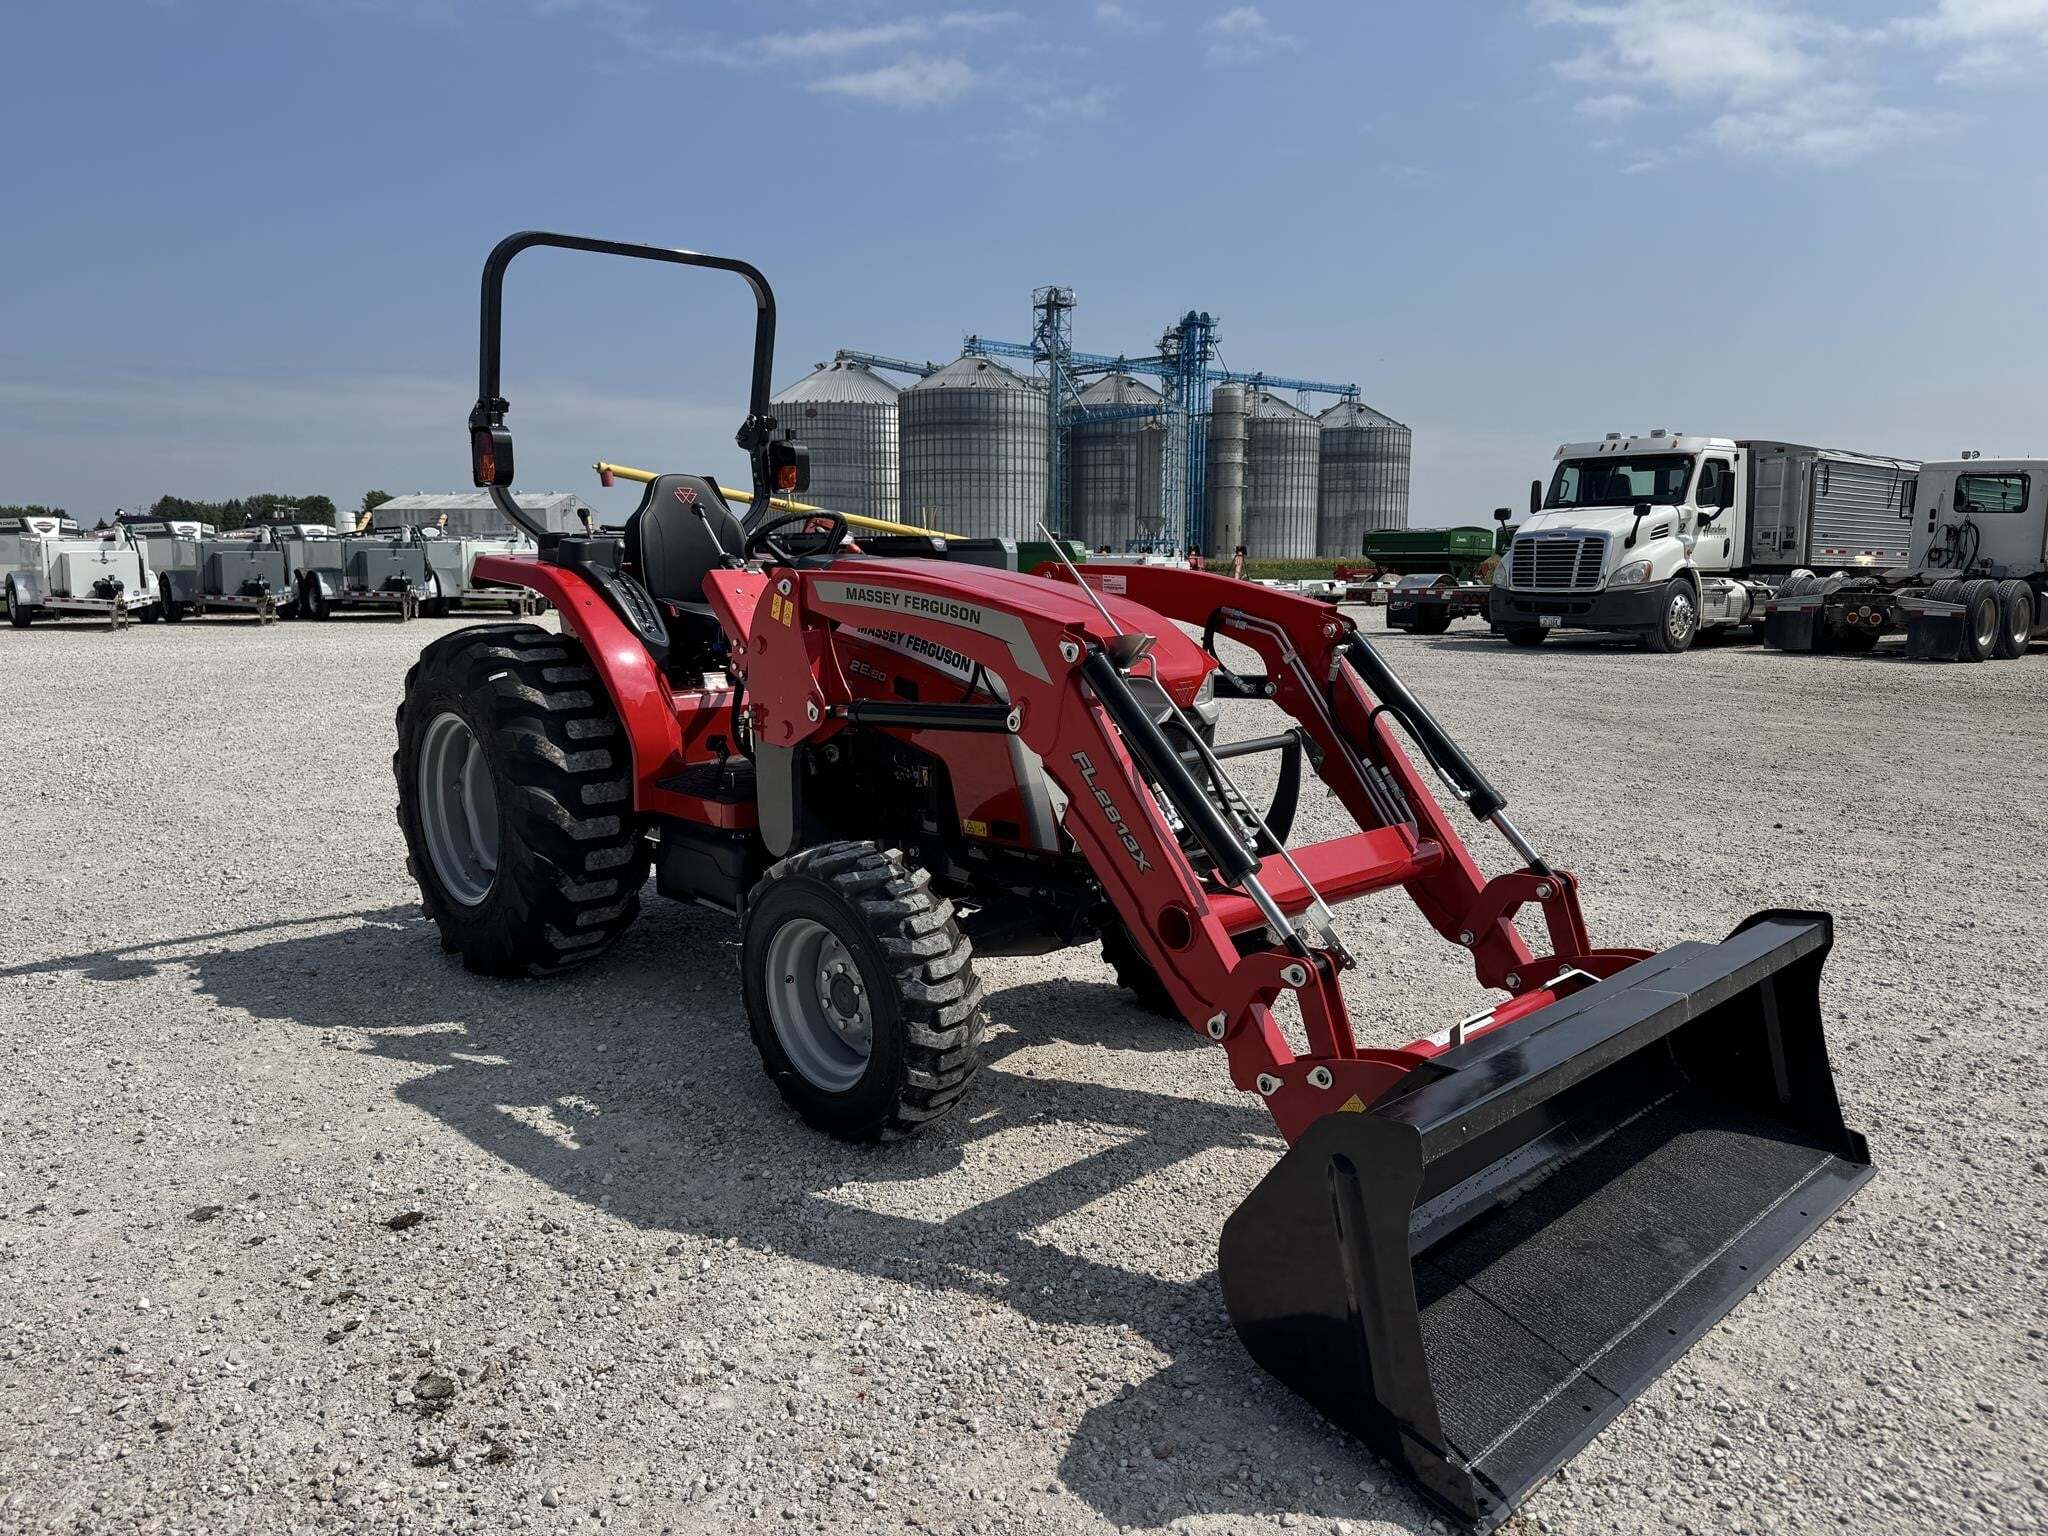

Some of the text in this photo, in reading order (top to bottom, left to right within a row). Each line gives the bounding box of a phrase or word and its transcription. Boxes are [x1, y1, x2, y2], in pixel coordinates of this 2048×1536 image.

[846, 587, 981, 625] MASSEY FERGUSON
[906, 634, 972, 673] FERGUSON
[1071, 751, 1153, 876] FL.2813X
